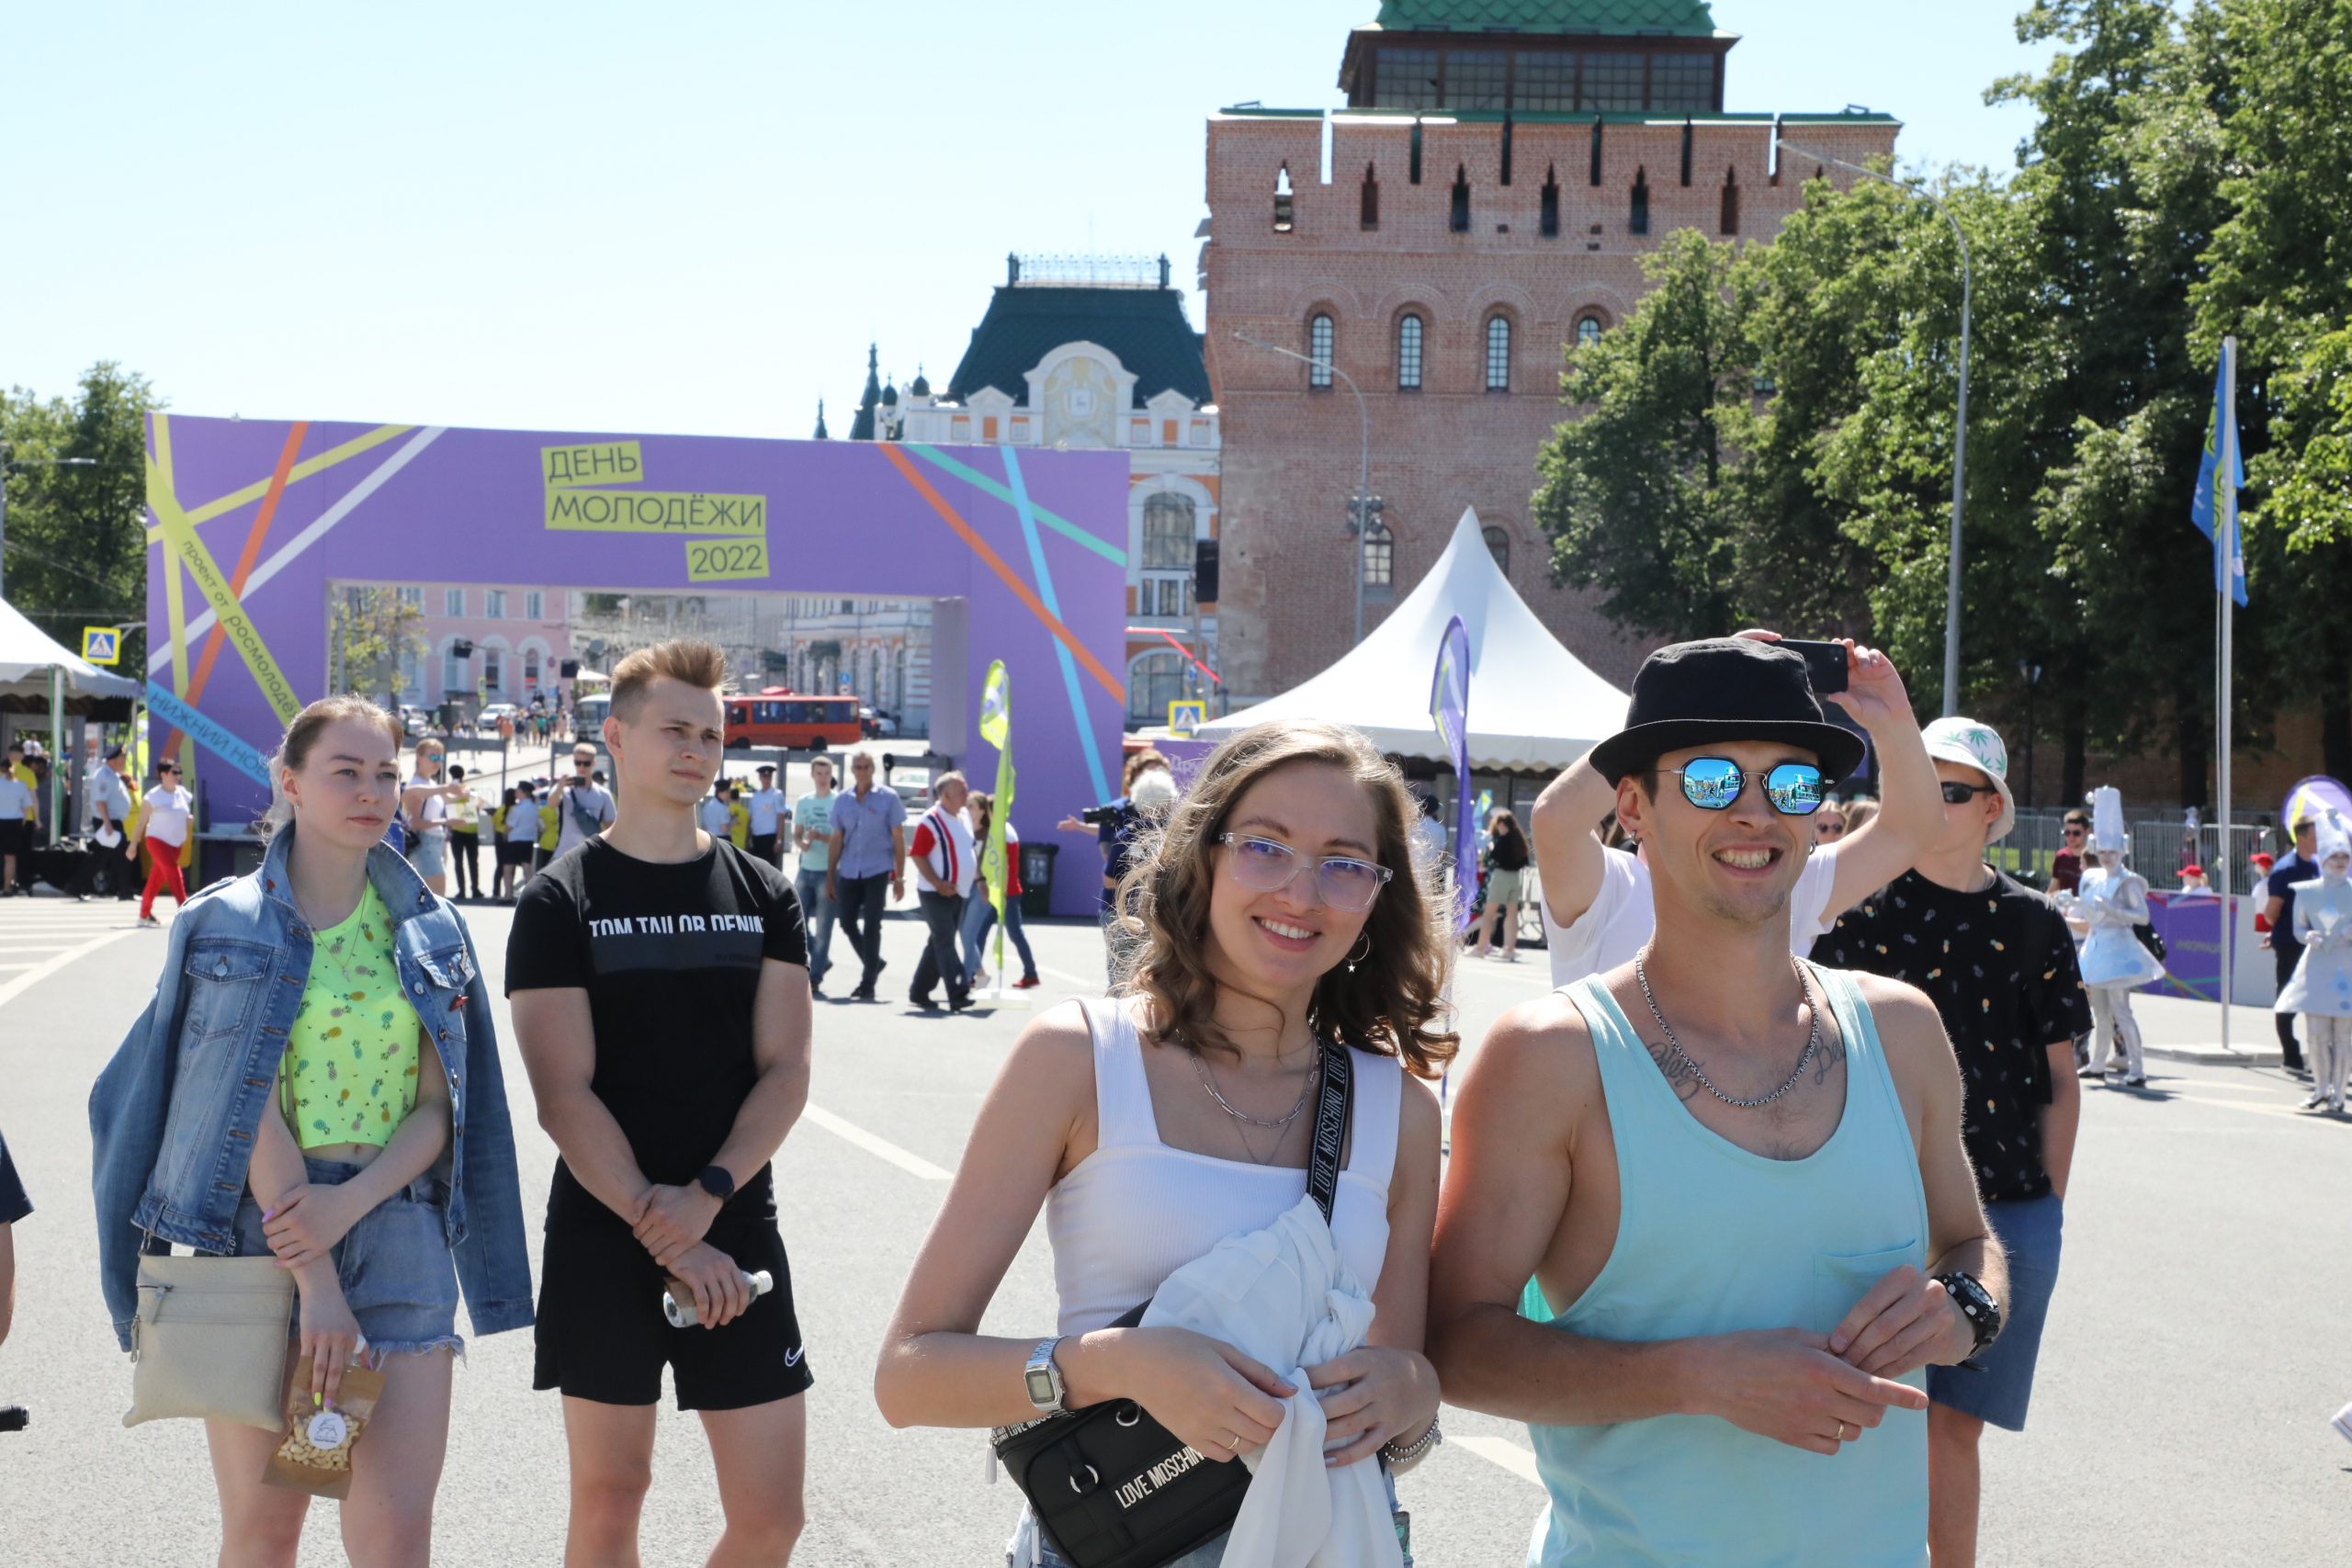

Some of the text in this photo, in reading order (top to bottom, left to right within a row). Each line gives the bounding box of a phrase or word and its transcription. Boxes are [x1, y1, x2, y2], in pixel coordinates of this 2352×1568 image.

[548, 446, 638, 483] ДЕНЬ
[551, 494, 763, 530] МОЛОДЁЖИ
[183, 540, 219, 590] проект
[214, 591, 230, 609] от
[692, 545, 763, 574] 2022
[151, 692, 271, 781] НИЖНИЙ НОВ
[589, 917, 633, 938] TOM
[1317, 1088, 1344, 1157] MOSCHINO
[1313, 1155, 1334, 1194] LOVE
[1114, 1445, 1206, 1509] LOVE MOSCHIN
